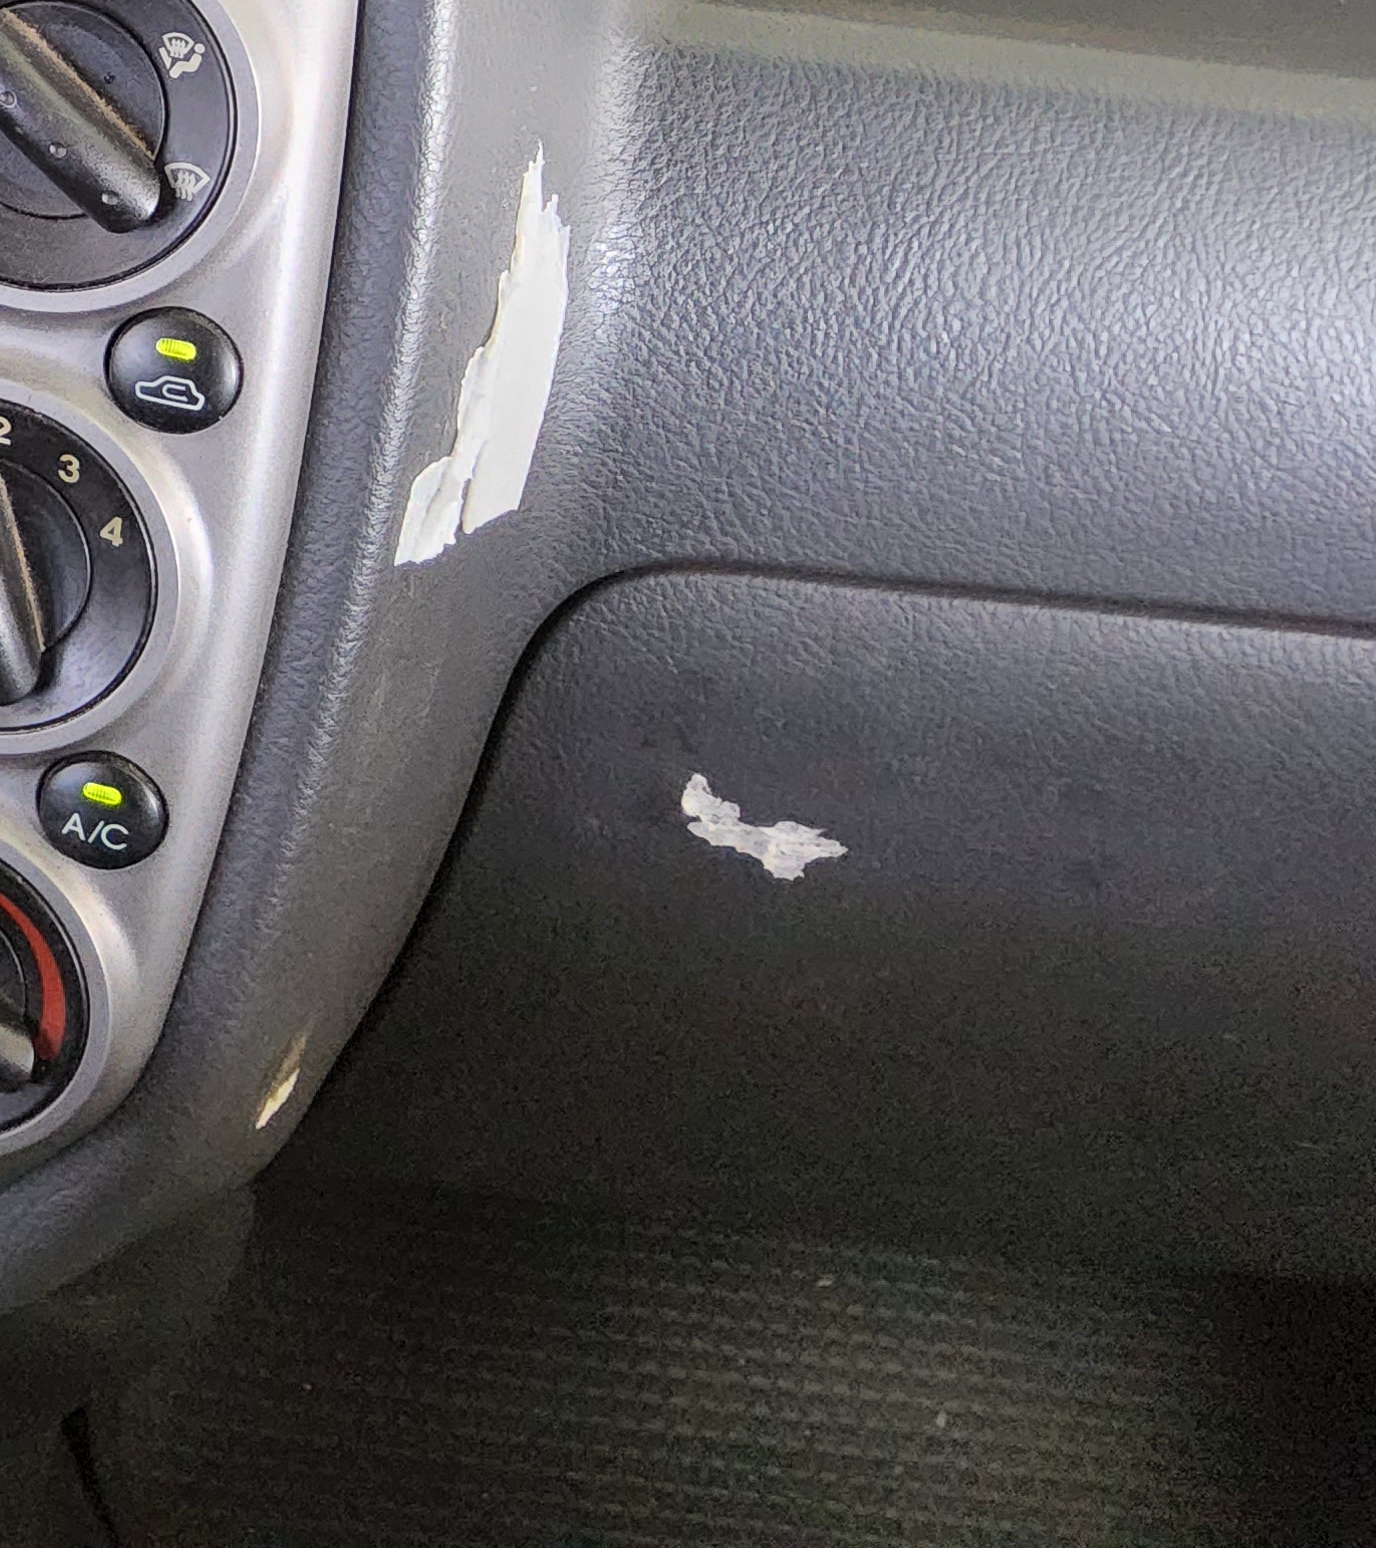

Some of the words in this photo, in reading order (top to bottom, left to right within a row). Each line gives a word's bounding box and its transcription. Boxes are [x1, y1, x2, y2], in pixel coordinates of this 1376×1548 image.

[58, 453, 81, 484] 3
[99, 516, 124, 548] 4
[61, 813, 131, 851] A/C
